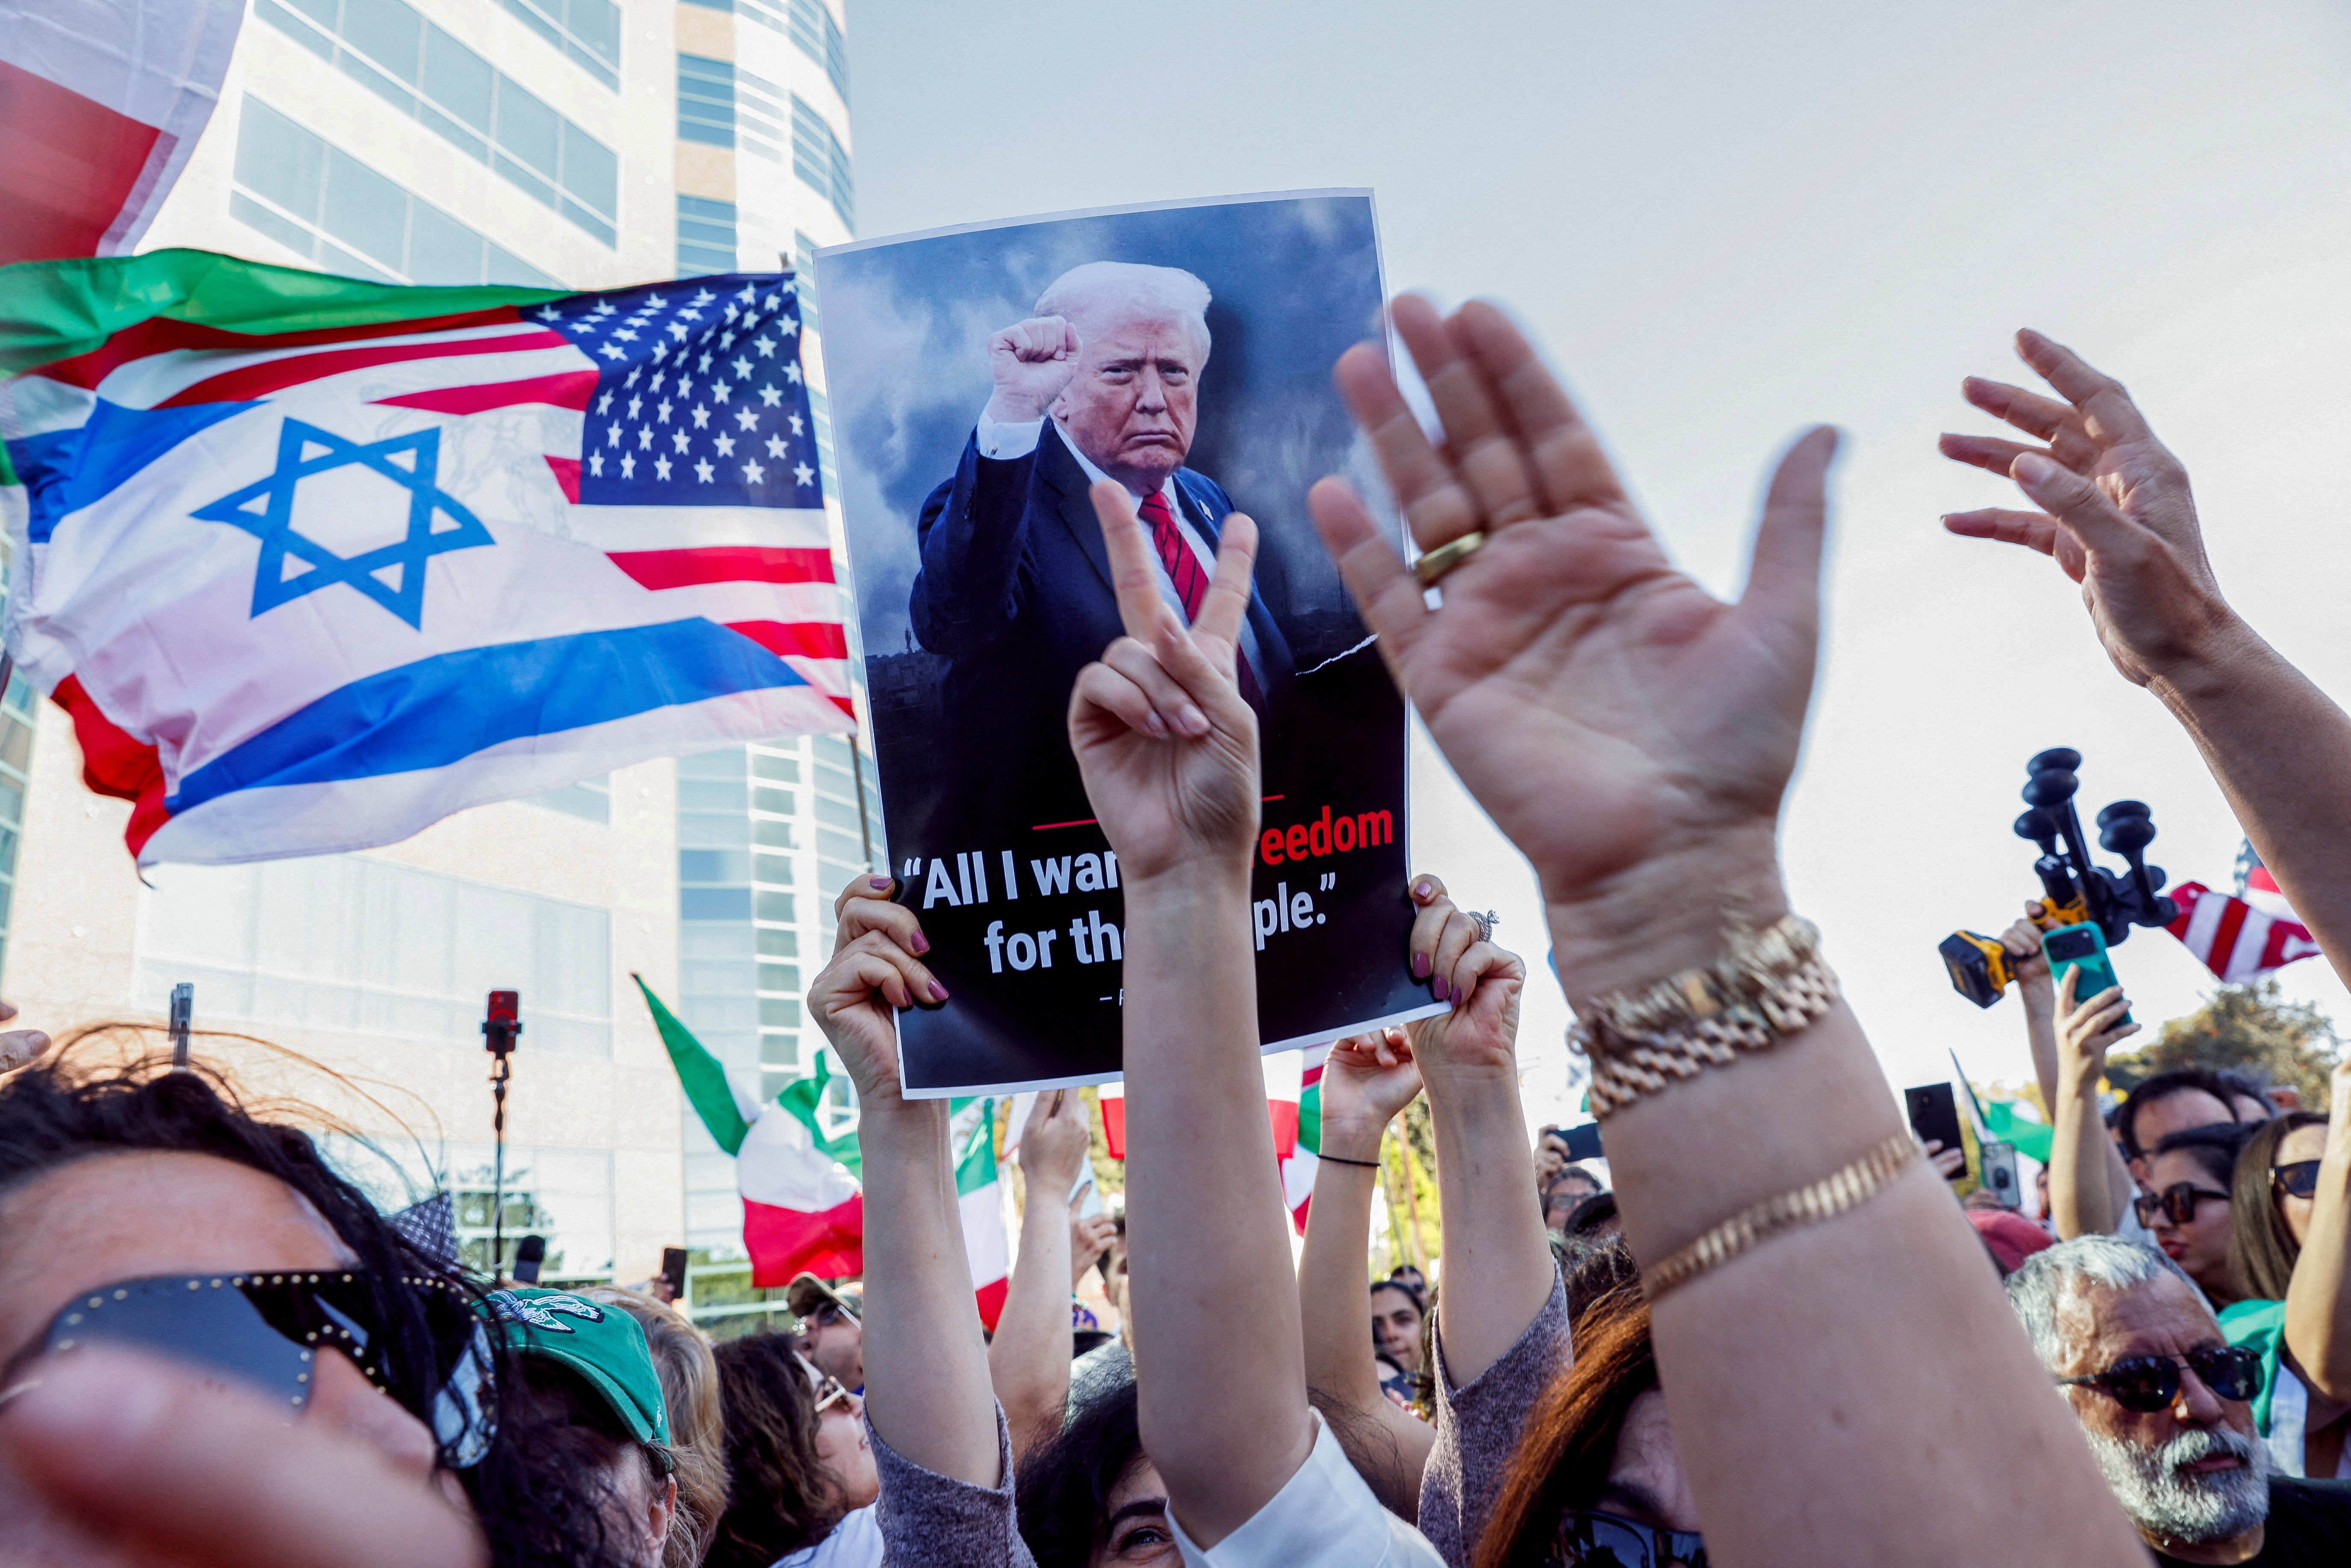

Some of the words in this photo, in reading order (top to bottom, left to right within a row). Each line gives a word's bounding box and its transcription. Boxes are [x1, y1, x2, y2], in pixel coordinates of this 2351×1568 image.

[904, 850, 989, 910] “All
[1001, 849, 1018, 900] I
[1252, 805, 1393, 868] eedom
[984, 920, 1057, 974] for
[1069, 909, 1126, 964] th
